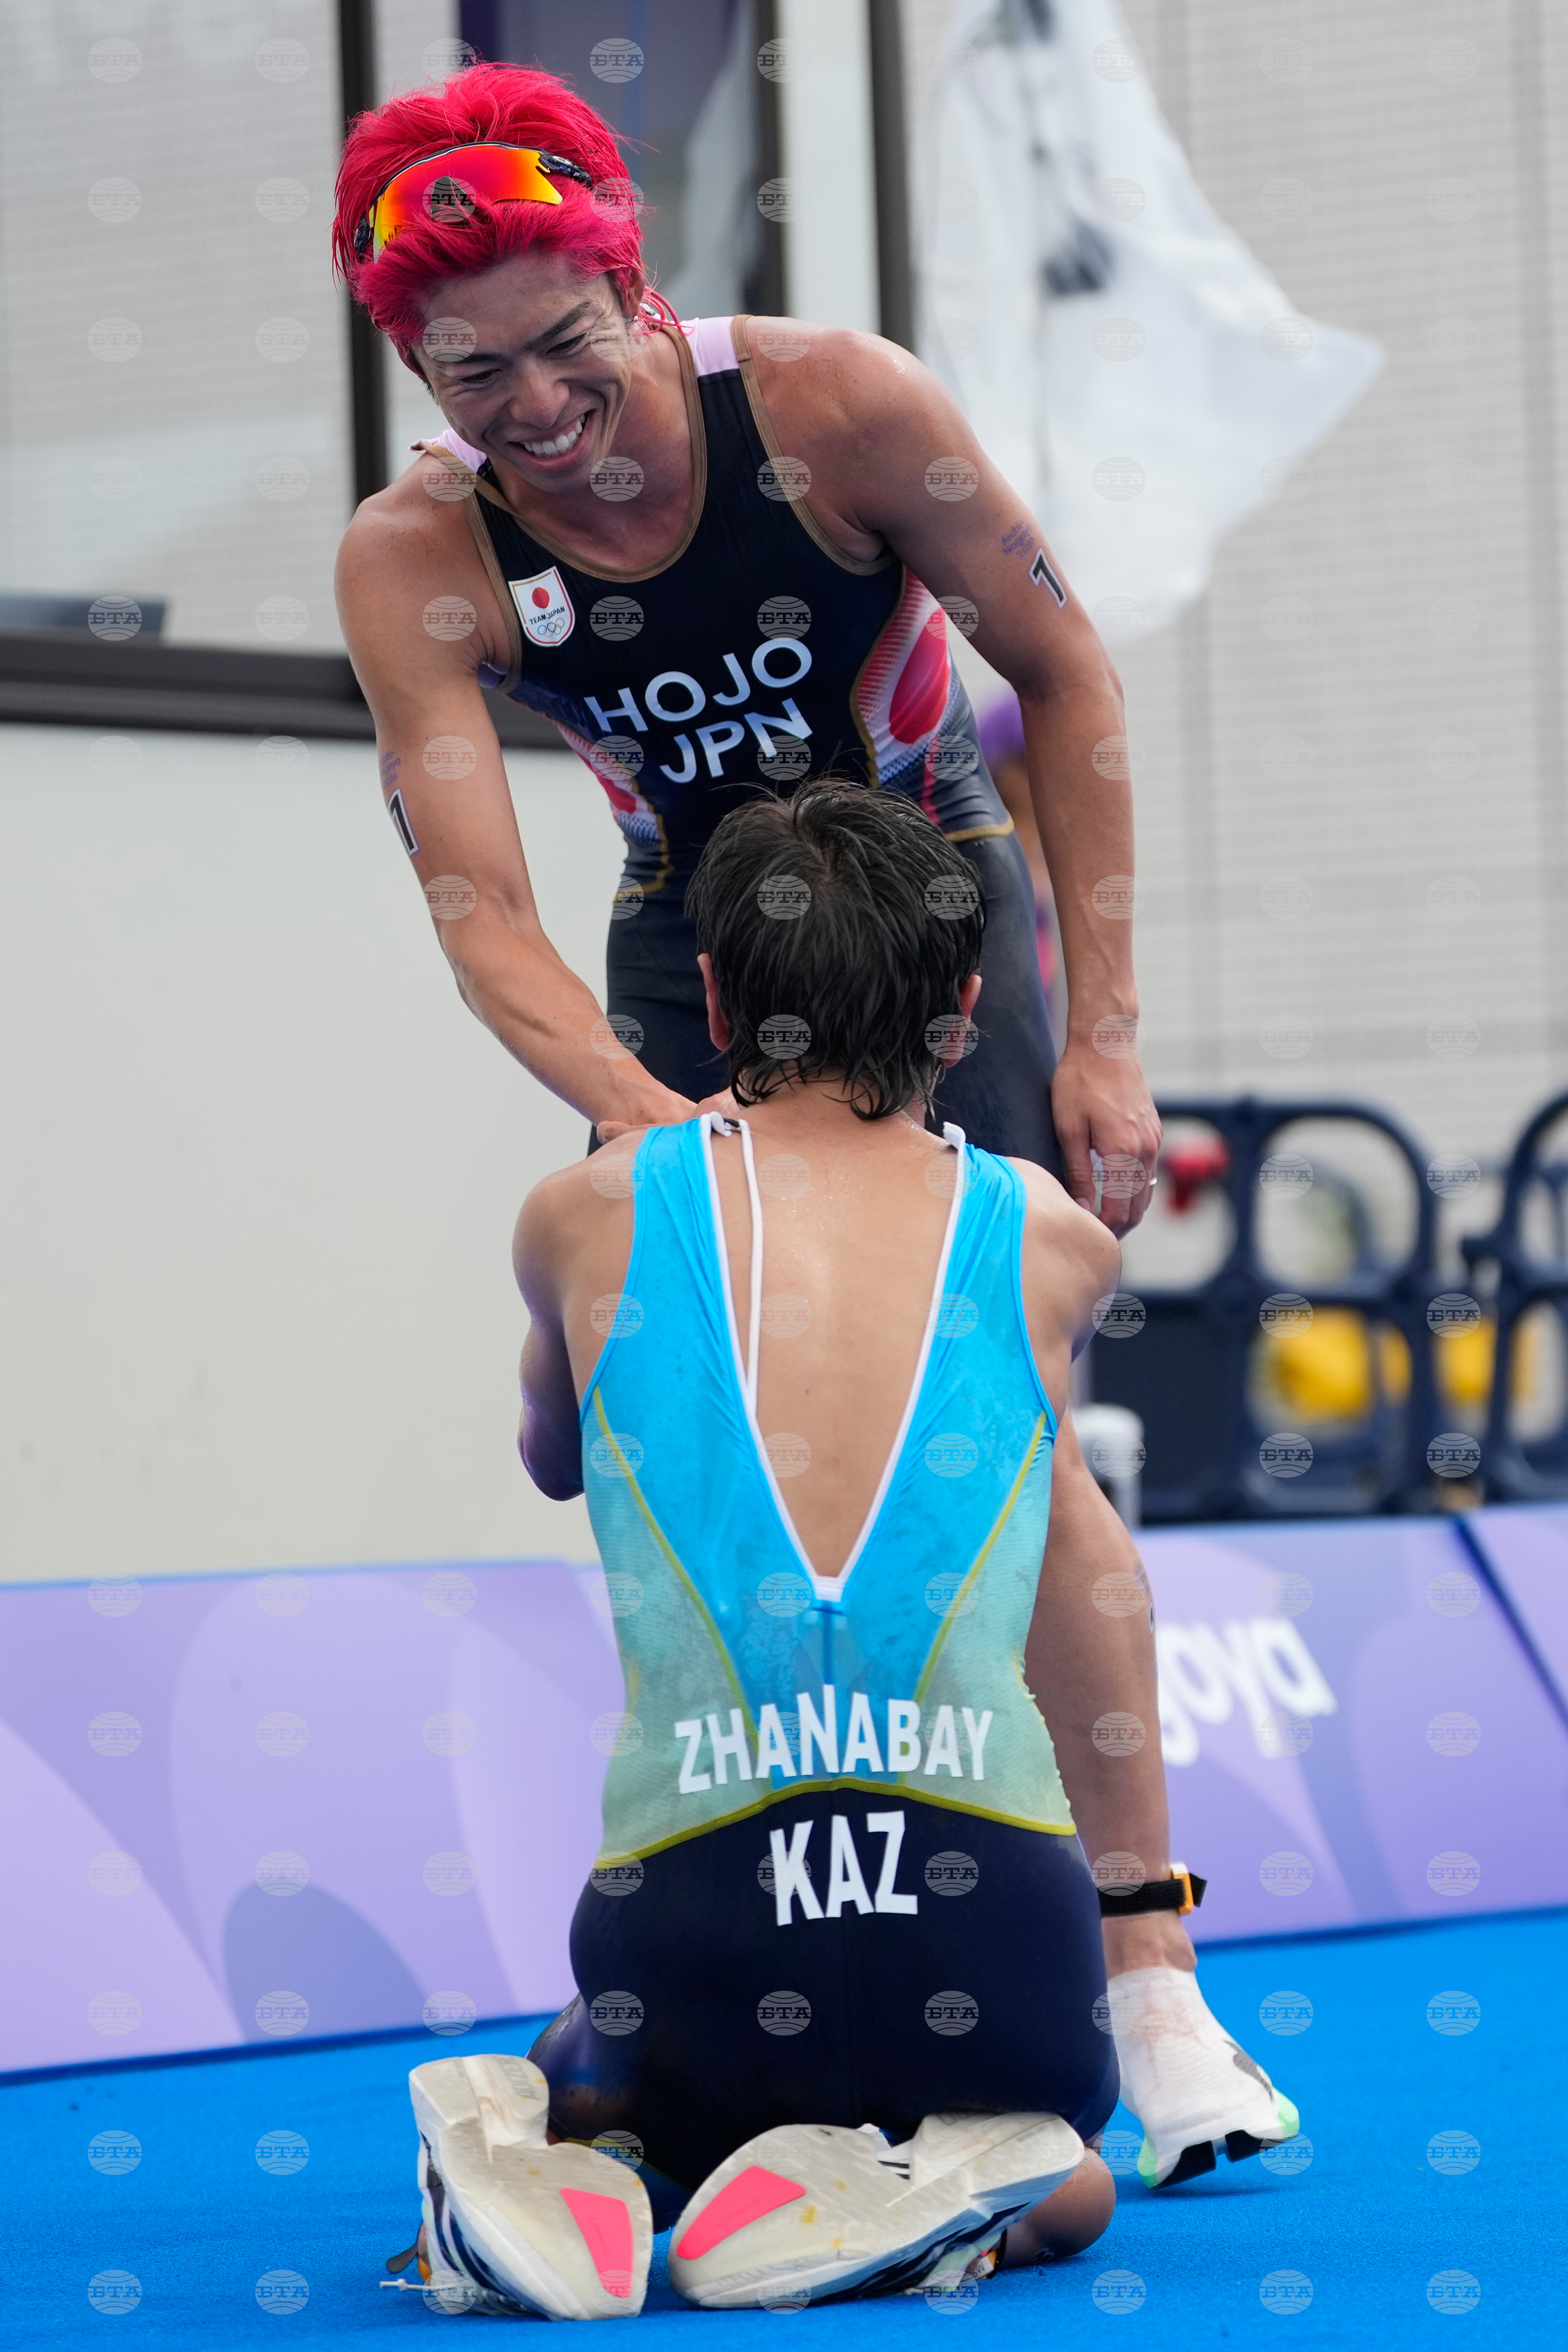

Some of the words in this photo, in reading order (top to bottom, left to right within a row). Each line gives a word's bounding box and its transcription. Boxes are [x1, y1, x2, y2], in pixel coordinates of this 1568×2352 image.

[529, 614, 547, 625] TEAM
[548, 605, 565, 619] JAPAN
[1029, 547, 1068, 609] 1
[584, 637, 812, 733] HOJO
[660, 697, 813, 783] JPN
[388, 788, 419, 855] 1
[675, 1684, 993, 1794] ZHANABAY
[770, 1810, 918, 1926] KAZ
